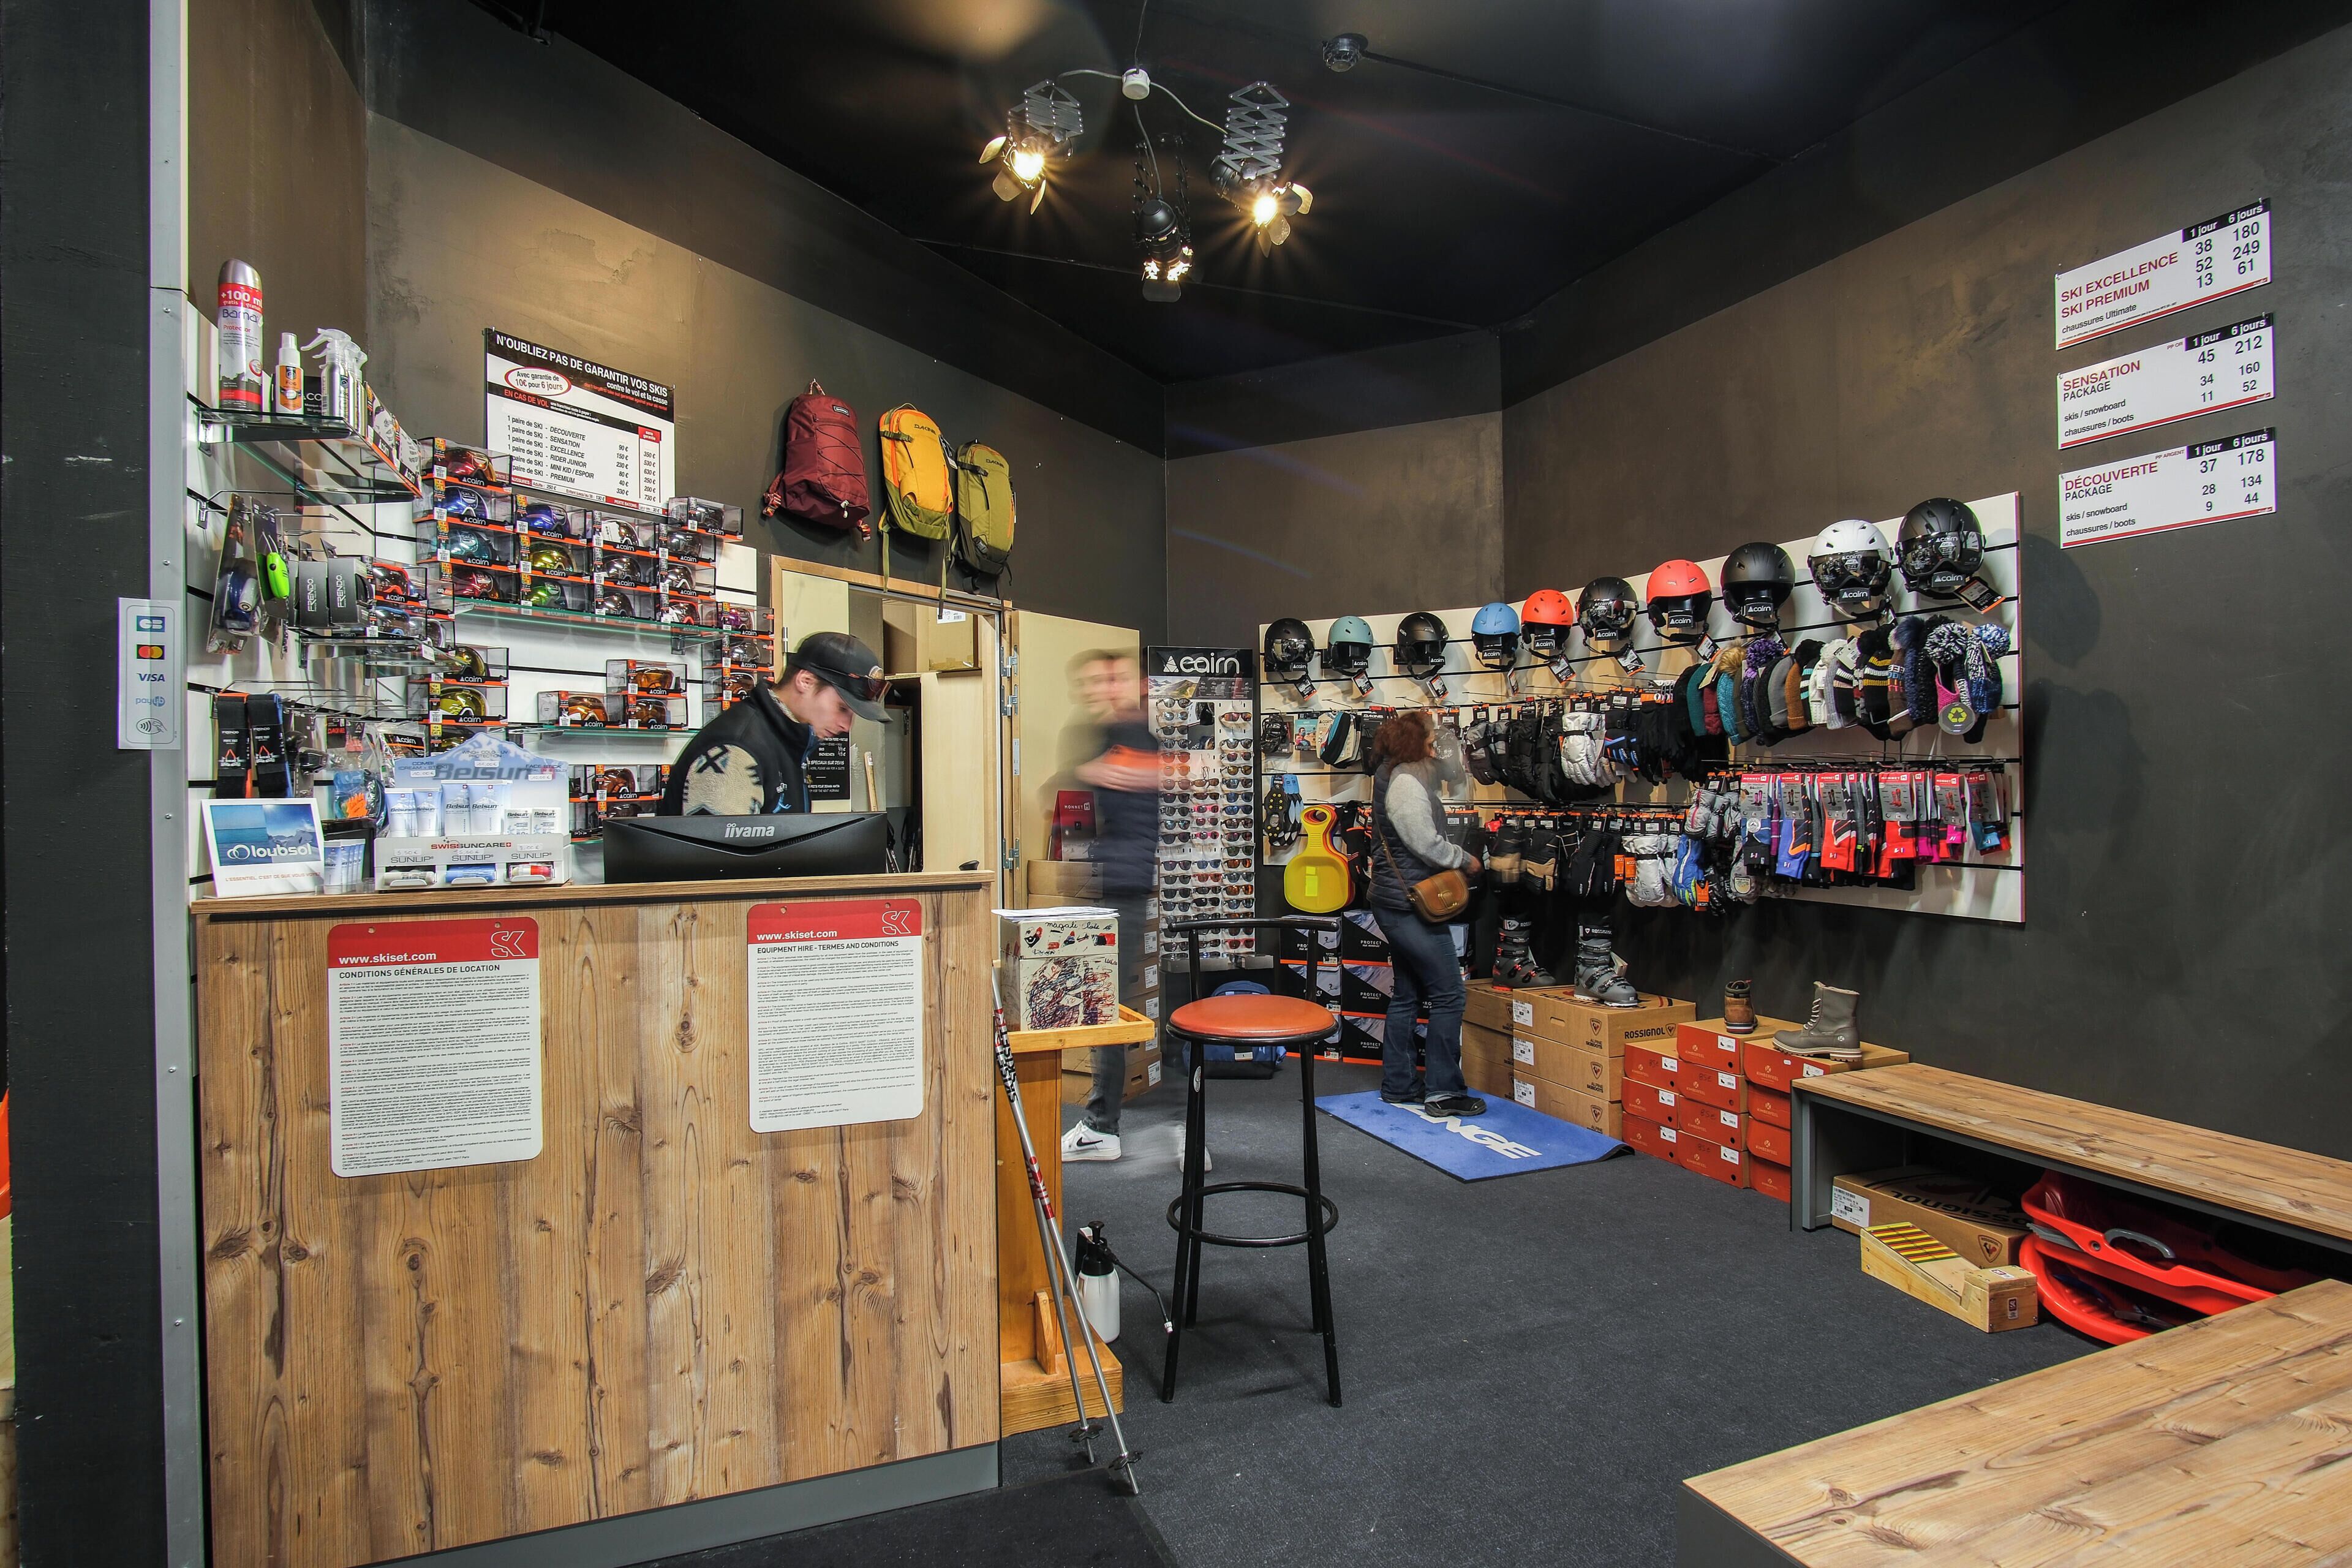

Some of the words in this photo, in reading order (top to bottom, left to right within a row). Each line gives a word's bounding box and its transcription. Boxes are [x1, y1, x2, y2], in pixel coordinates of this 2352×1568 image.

[2228, 214, 2234, 223] 6
[2237, 205, 2263, 222] jours
[2198, 221, 2217, 236] jour
[2061, 286, 2082, 302] SKI
[2086, 252, 2178, 294] EXCELLENCE
[2195, 239, 2212, 255] 38
[2233, 222, 2260, 241] 180
[2062, 303, 2082, 318] SKI
[2086, 279, 2149, 310] PREMIUM
[2196, 257, 2212, 273] 52
[2233, 240, 2260, 260] 249
[221, 290, 250, 303] +100
[2062, 315, 2103, 333] chaussures
[2106, 304, 2136, 318] Ultimate
[2197, 273, 2213, 288] 13
[2238, 259, 2254, 274] 61
[222, 309, 258, 323] Bama
[2239, 320, 2265, 334] jours
[2193, 338, 2198, 347] 1
[2200, 332, 2220, 345] jour
[2063, 361, 2140, 391] SENSATION
[2198, 350, 2214, 364] 45
[2235, 336, 2262, 354] 212
[550, 352, 568, 366] PAS
[570, 358, 582, 371] DE
[585, 363, 628, 385] GARANTIR
[630, 377, 647, 391] VOS
[649, 383, 668, 397] SKIS
[547, 382, 563, 391] jours
[607, 382, 624, 393] contre
[2063, 381, 2110, 401] PACKAGE
[2064, 408, 2078, 421] skis
[2085, 399, 2126, 418] snowboard
[2200, 374, 2214, 386] 34
[2239, 362, 2260, 375] 160
[537, 398, 549, 407] VOL
[2065, 421, 2106, 437] chaussures
[2113, 413, 2134, 425] boots
[2201, 391, 2213, 402] 11
[2242, 380, 2256, 392] 52
[550, 427, 586, 440] DECOUVERTE
[2233, 438, 2239, 447] 6
[2241, 433, 2267, 447] jours
[550, 435, 580, 448] SENSATION
[550, 445, 585, 459] EXCELLENCE
[2195, 447, 2199, 456] 1
[2202, 443, 2222, 456] jour
[551, 454, 567, 463] RIDER
[567, 458, 587, 468] JUNIOR
[575, 469, 594, 479] ESPOIR
[2065, 462, 2158, 491] DÉCOUVERTE
[2200, 459, 2217, 473] 37
[2237, 449, 2264, 466] 178
[551, 473, 575, 483] PREMIUM
[2065, 483, 2112, 501] PACKAGE
[2066, 510, 2080, 521] skis
[2086, 503, 2127, 517] snowboard
[2202, 484, 2215, 495] 28
[2241, 475, 2261, 488] 134
[2066, 524, 2108, 537] chaussures
[2114, 518, 2135, 528] boots
[2206, 502, 2212, 511] 9
[2244, 493, 2258, 503] 44
[307, 578, 317, 612] FRENDO
[336, 575, 346, 608] FRENDO
[1180, 652, 1240, 674] cairn
[137, 673, 165, 682] VISA
[725, 823, 775, 838] iiyama
[252, 843, 312, 858] loubsol
[757, 930, 837, 941] www.skiset.com
[339, 952, 437, 965] www.skiset.com
[339, 970, 391, 979] CONDITIONS
[394, 965, 444, 976] GÉNÉRALES
[461, 964, 500, 973] LOCATION
[1624, 1027, 1665, 1039] ROSSIGNOL
